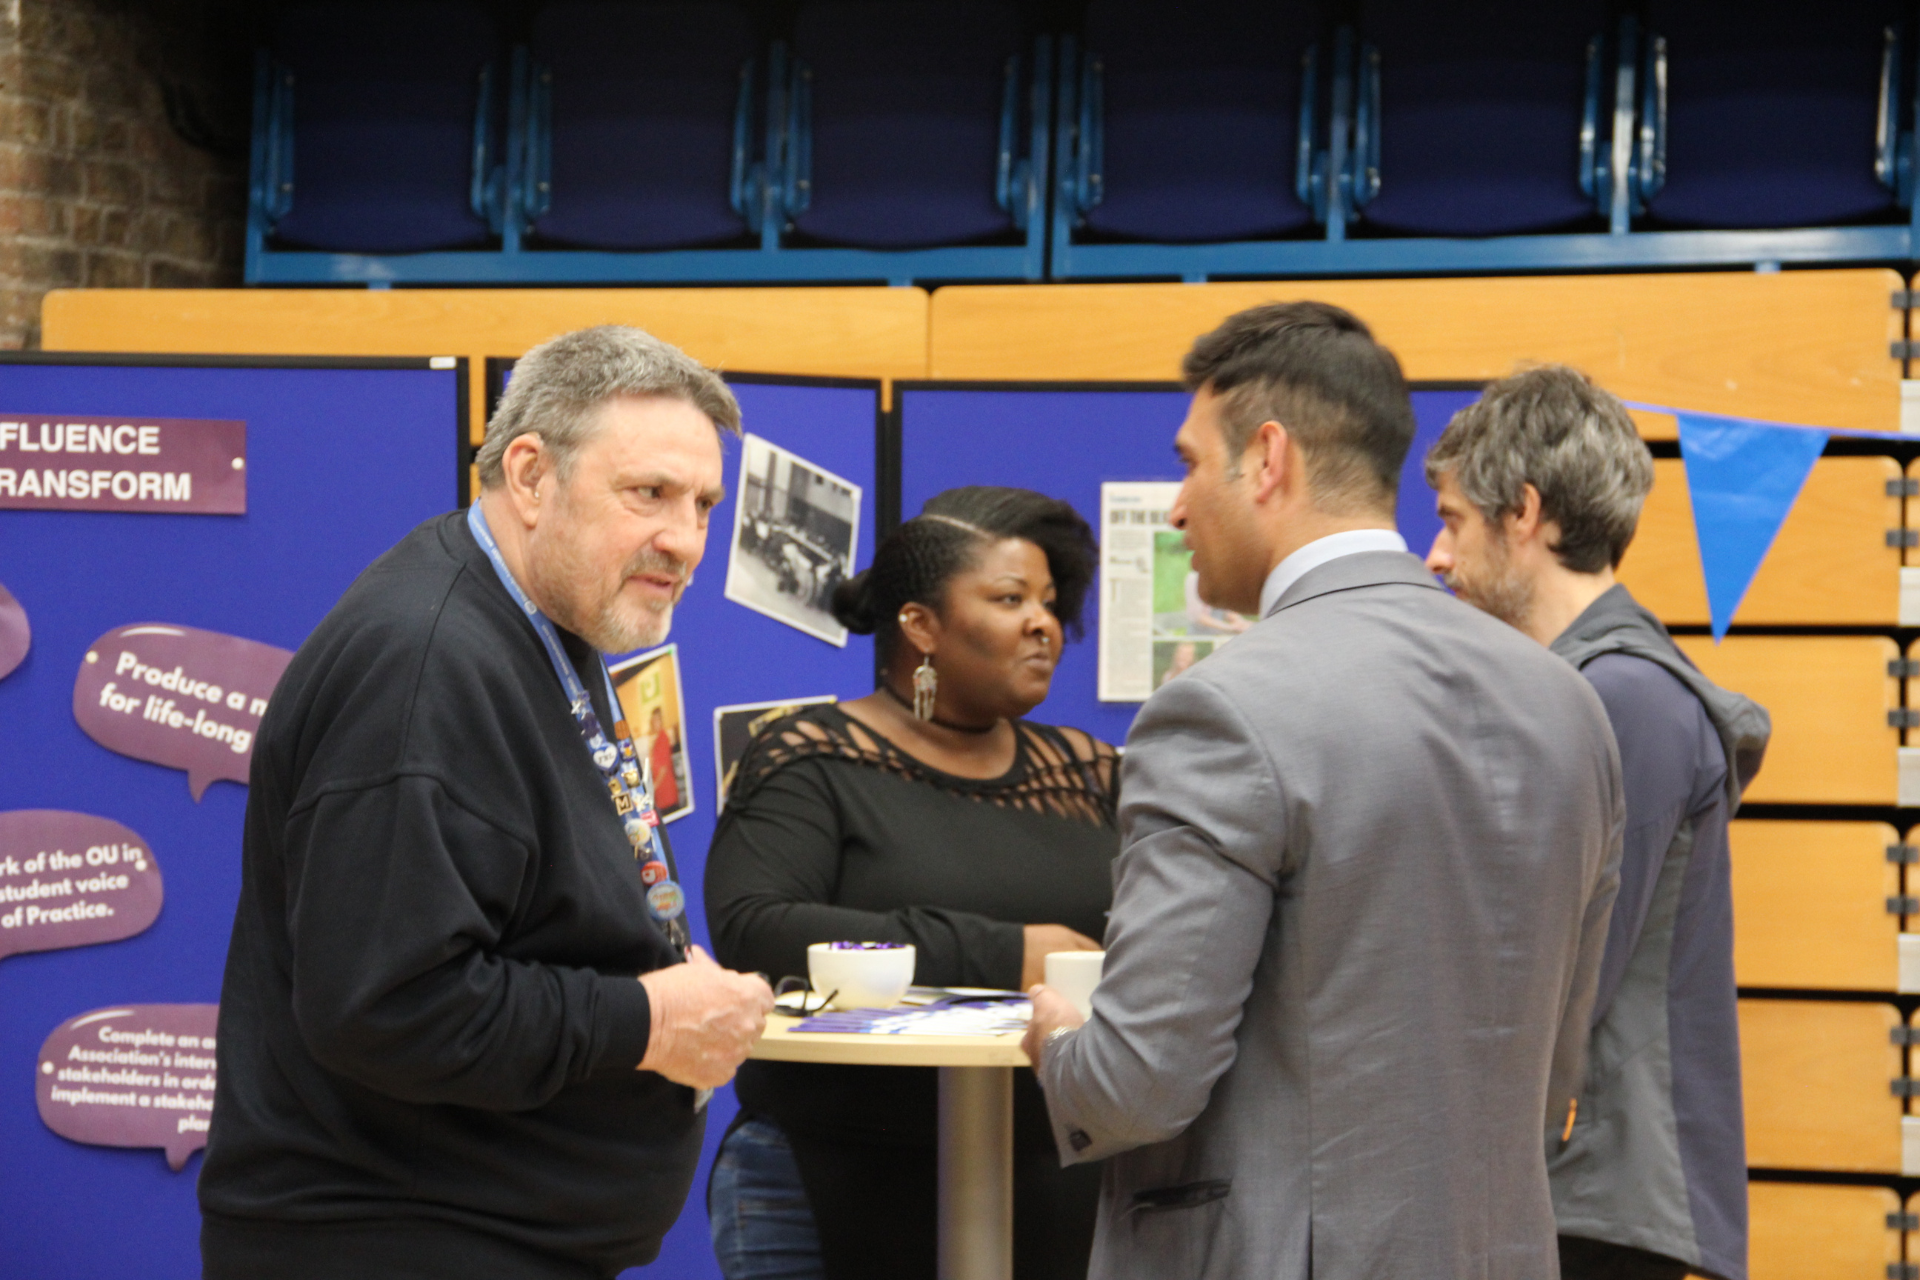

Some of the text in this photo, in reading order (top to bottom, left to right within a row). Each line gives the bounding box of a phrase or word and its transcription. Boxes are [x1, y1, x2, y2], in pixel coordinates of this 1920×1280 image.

[0, 422, 161, 455] FLUENCE
[0, 467, 192, 501] RANSFORM
[115, 650, 223, 703] Produce
[226, 691, 247, 711] a
[99, 681, 252, 754] for life-long
[23, 851, 46, 874] of
[49, 850, 83, 871] the
[85, 844, 119, 867] OU
[121, 843, 143, 863] in
[0, 872, 129, 904] student voice
[0, 900, 115, 929] of Practice.
[98, 1025, 175, 1048] Complete
[177, 1036, 199, 1049] an
[67, 1044, 171, 1068] Association's
[57, 1066, 160, 1088] stakeholders
[163, 1071, 179, 1088] in
[50, 1085, 137, 1107] implement
[139, 1095, 152, 1108] a
